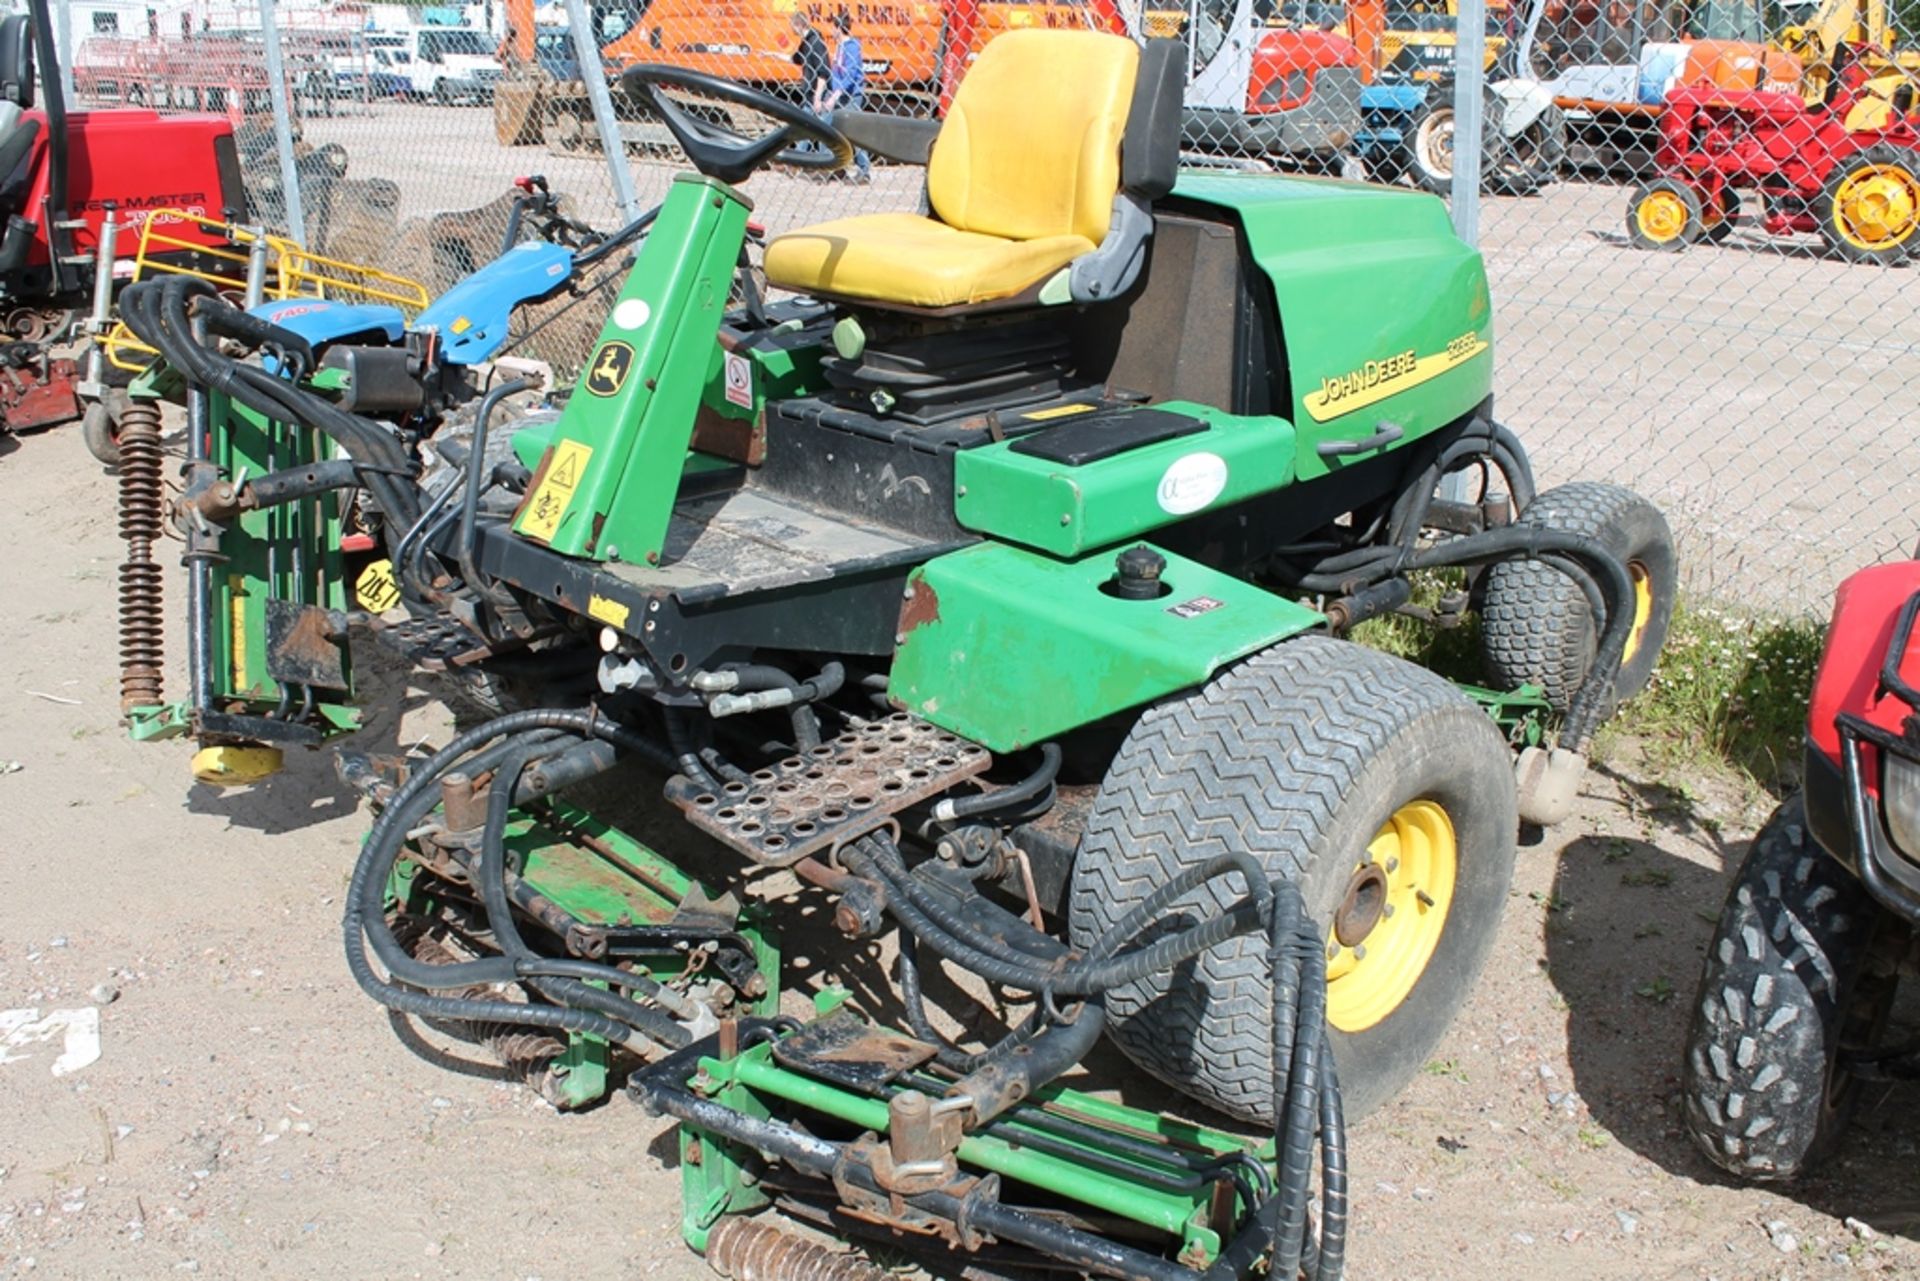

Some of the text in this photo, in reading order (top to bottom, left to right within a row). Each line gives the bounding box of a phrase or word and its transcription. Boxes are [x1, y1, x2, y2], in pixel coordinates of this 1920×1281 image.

[73, 192, 206, 212] RELMASTER
[1318, 350, 1418, 406] JOHN DEERE
